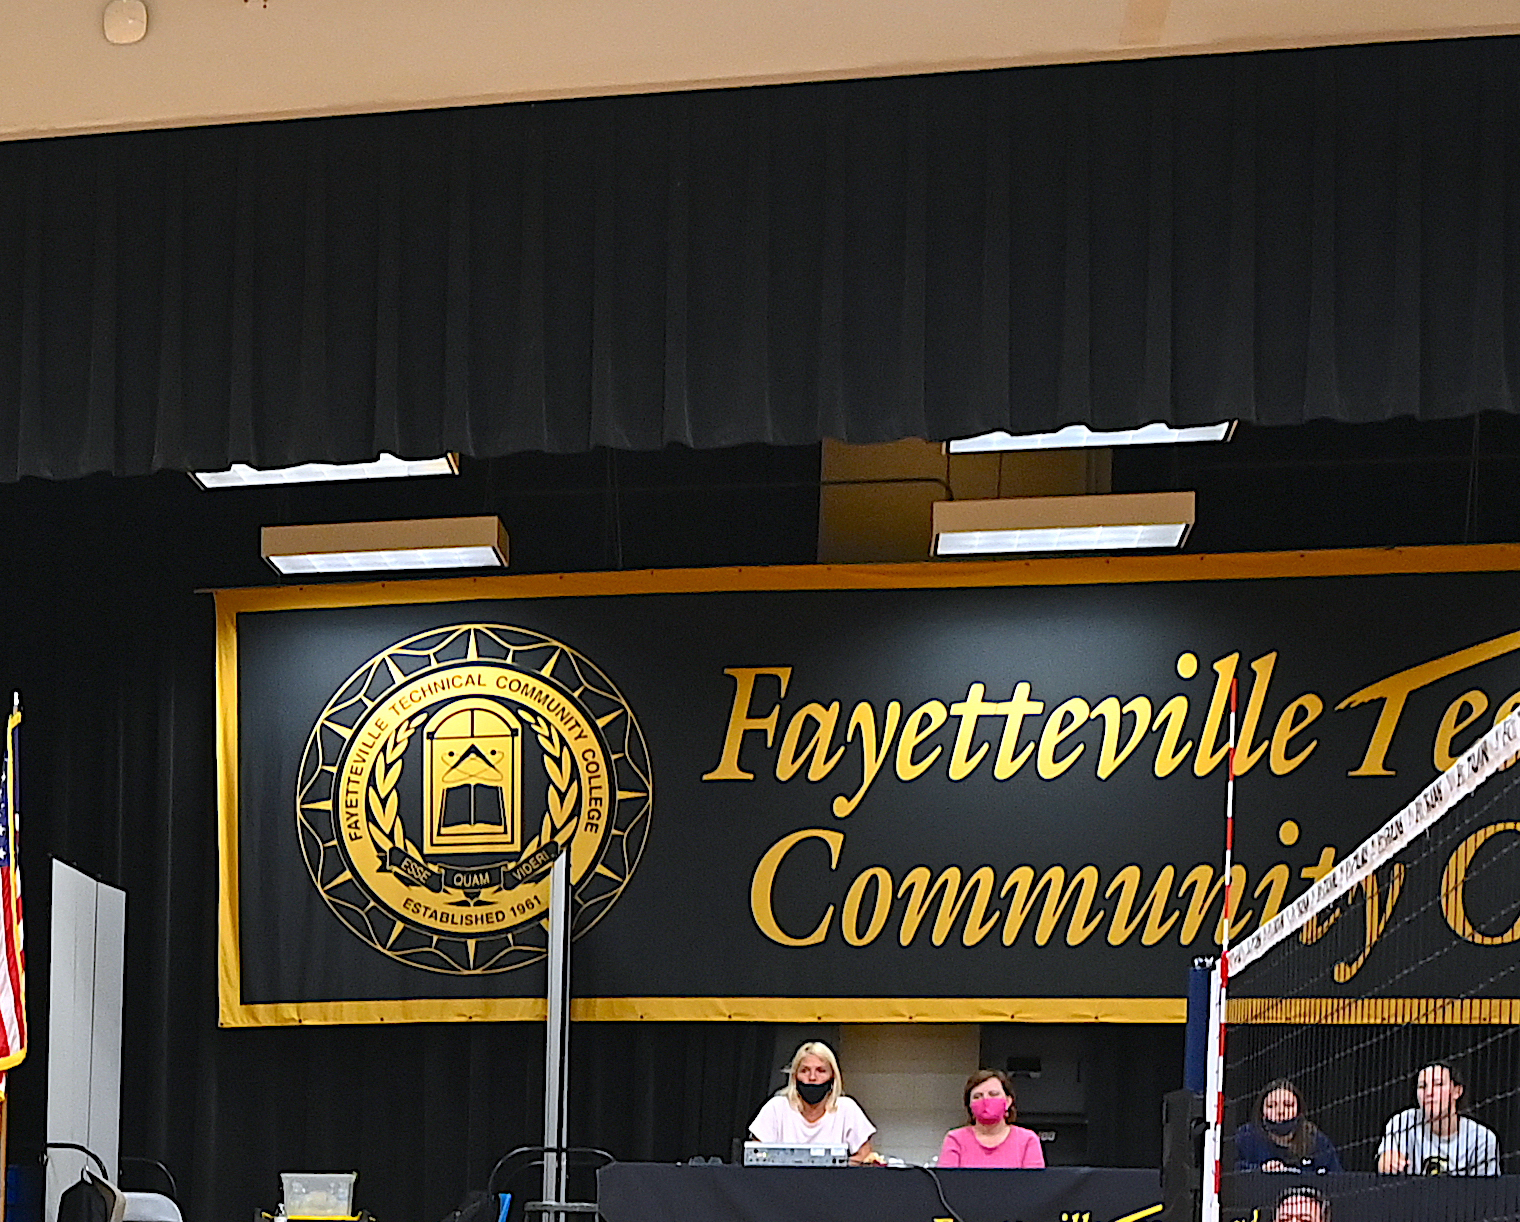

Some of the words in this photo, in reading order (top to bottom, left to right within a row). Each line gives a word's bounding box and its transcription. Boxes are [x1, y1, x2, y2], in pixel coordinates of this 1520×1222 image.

[345, 718, 388, 842] FAYETTEVILLE
[389, 673, 486, 715] TECHNICAL
[496, 675, 588, 742] COMMUNITY
[582, 748, 603, 834] COLLEGE
[701, 651, 1320, 818] Fayetteville
[400, 857, 431, 884] ESSE
[512, 851, 550, 881] VIDERI
[402, 897, 506, 926] ESTABLISHED
[510, 895, 542, 918] 1961
[750, 819, 1406, 984] Community
